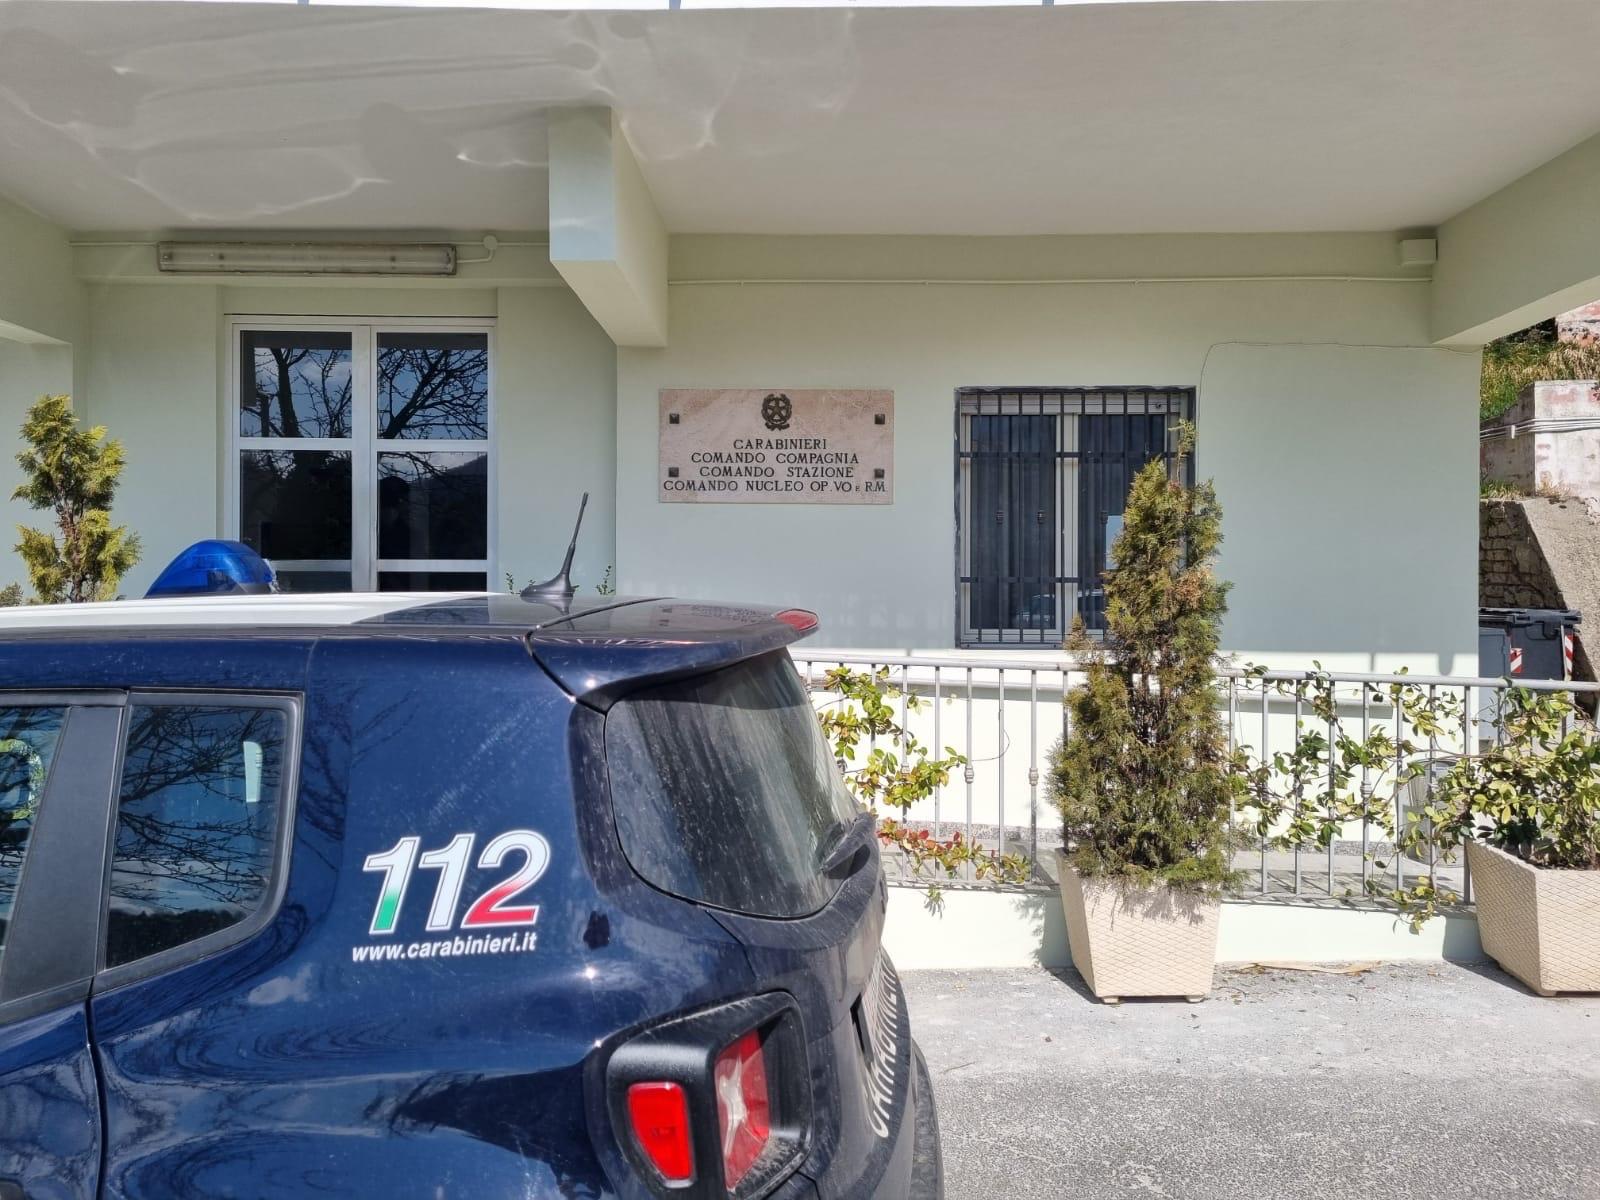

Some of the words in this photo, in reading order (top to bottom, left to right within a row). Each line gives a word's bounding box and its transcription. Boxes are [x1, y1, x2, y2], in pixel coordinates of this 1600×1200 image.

[733, 438, 827, 450] CARABINIERI
[691, 452, 766, 464] COMANDO
[776, 453, 859, 464] COMPAGNIA
[699, 466, 775, 478] COMANDO
[787, 466, 854, 478] STAZIONE
[663, 480, 739, 492] COMANDO
[746, 480, 804, 492] NUCLEO
[362, 829, 551, 935] 112
[352, 931, 537, 962] www.carabinieri.it
